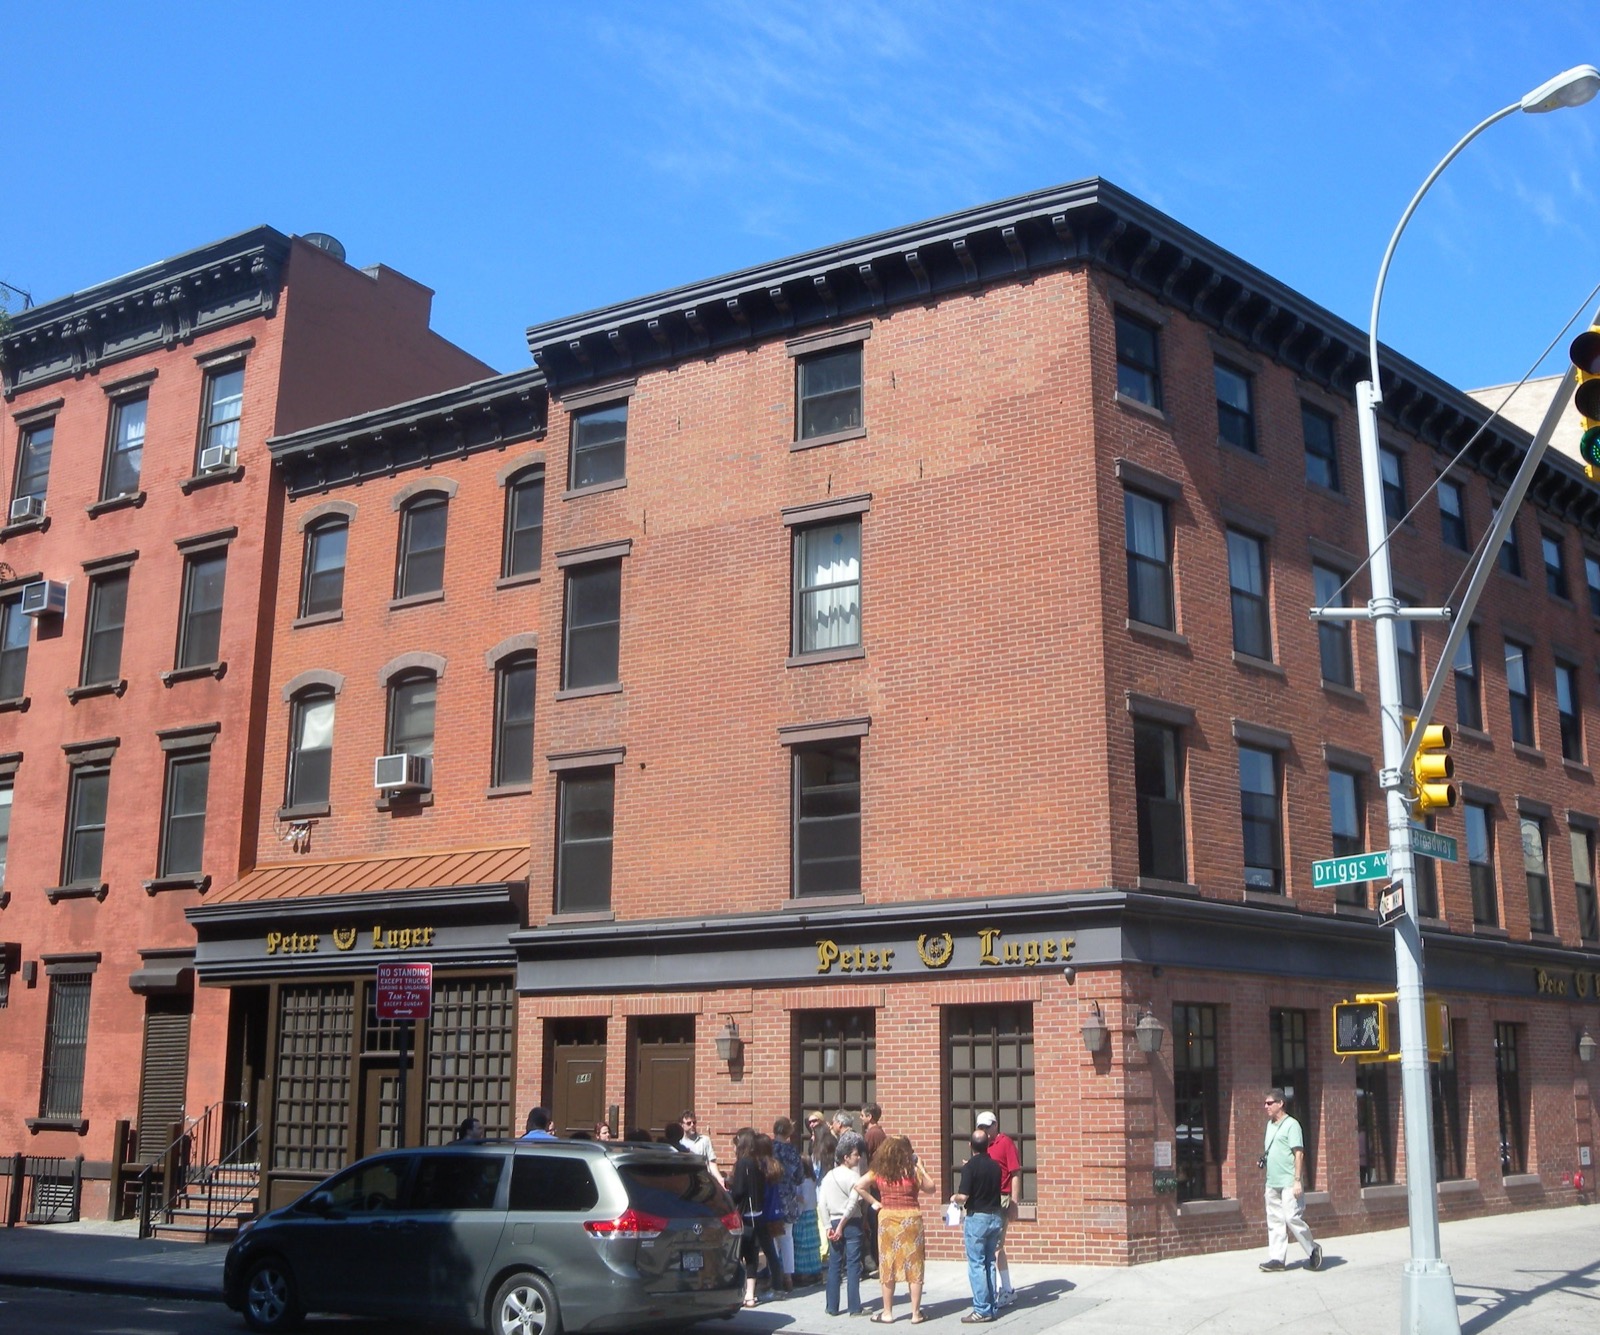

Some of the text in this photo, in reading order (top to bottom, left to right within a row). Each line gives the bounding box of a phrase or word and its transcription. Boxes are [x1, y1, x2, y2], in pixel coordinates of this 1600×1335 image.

[1412, 830, 1451, 859] Broadway
[1314, 860, 1367, 883] Driggs
[266, 925, 434, 954] Peter Luger
[815, 928, 1075, 972] Peter Luger
[380, 968, 430, 977] NO STANDING
